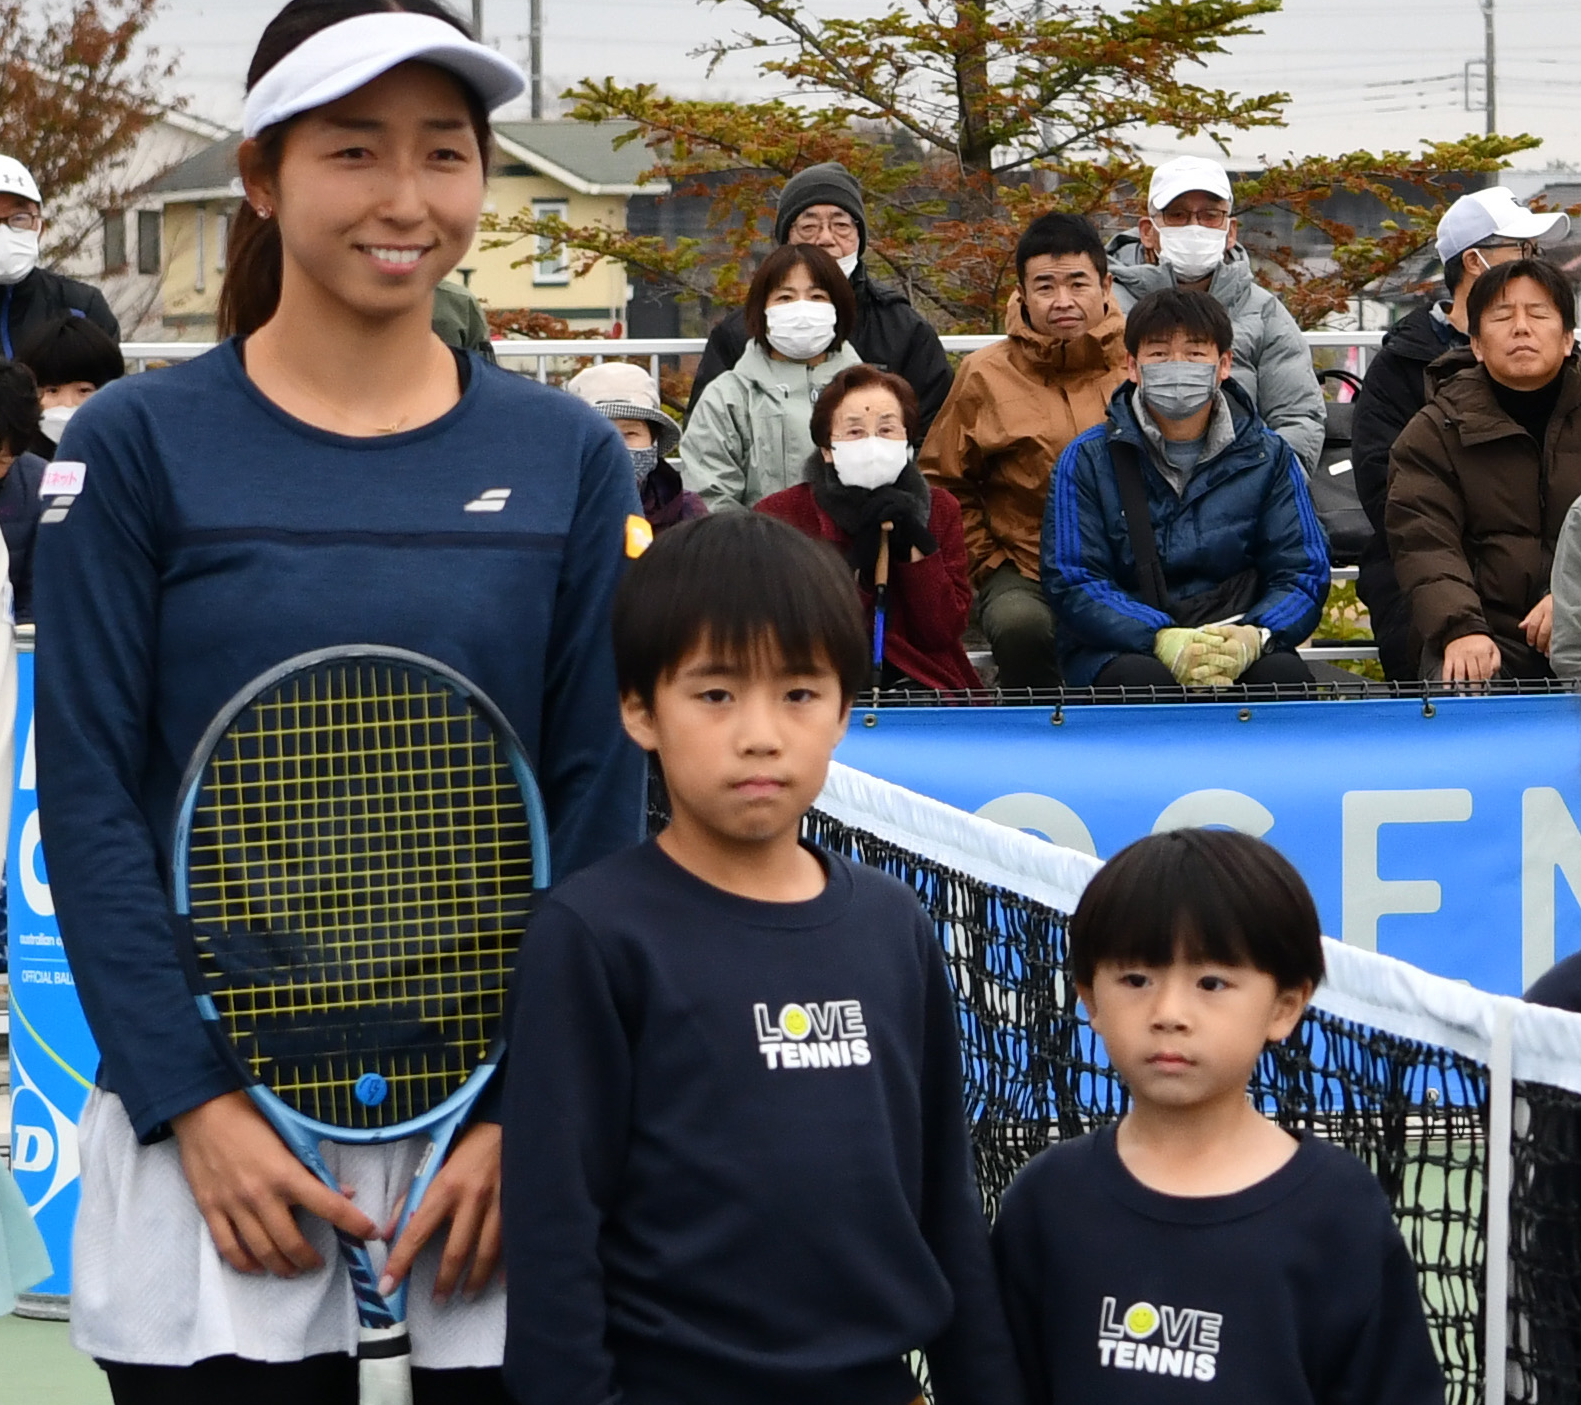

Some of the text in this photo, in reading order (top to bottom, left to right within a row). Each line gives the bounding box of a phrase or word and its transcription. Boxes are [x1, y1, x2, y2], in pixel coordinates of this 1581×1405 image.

[22, 970, 53, 984] OFFICIAL
[753, 1000, 867, 1042] LOVE
[759, 1039, 872, 1070] TENNIS
[1099, 1296, 1223, 1354] LOVE
[1098, 1338, 1217, 1382] TENNIS
